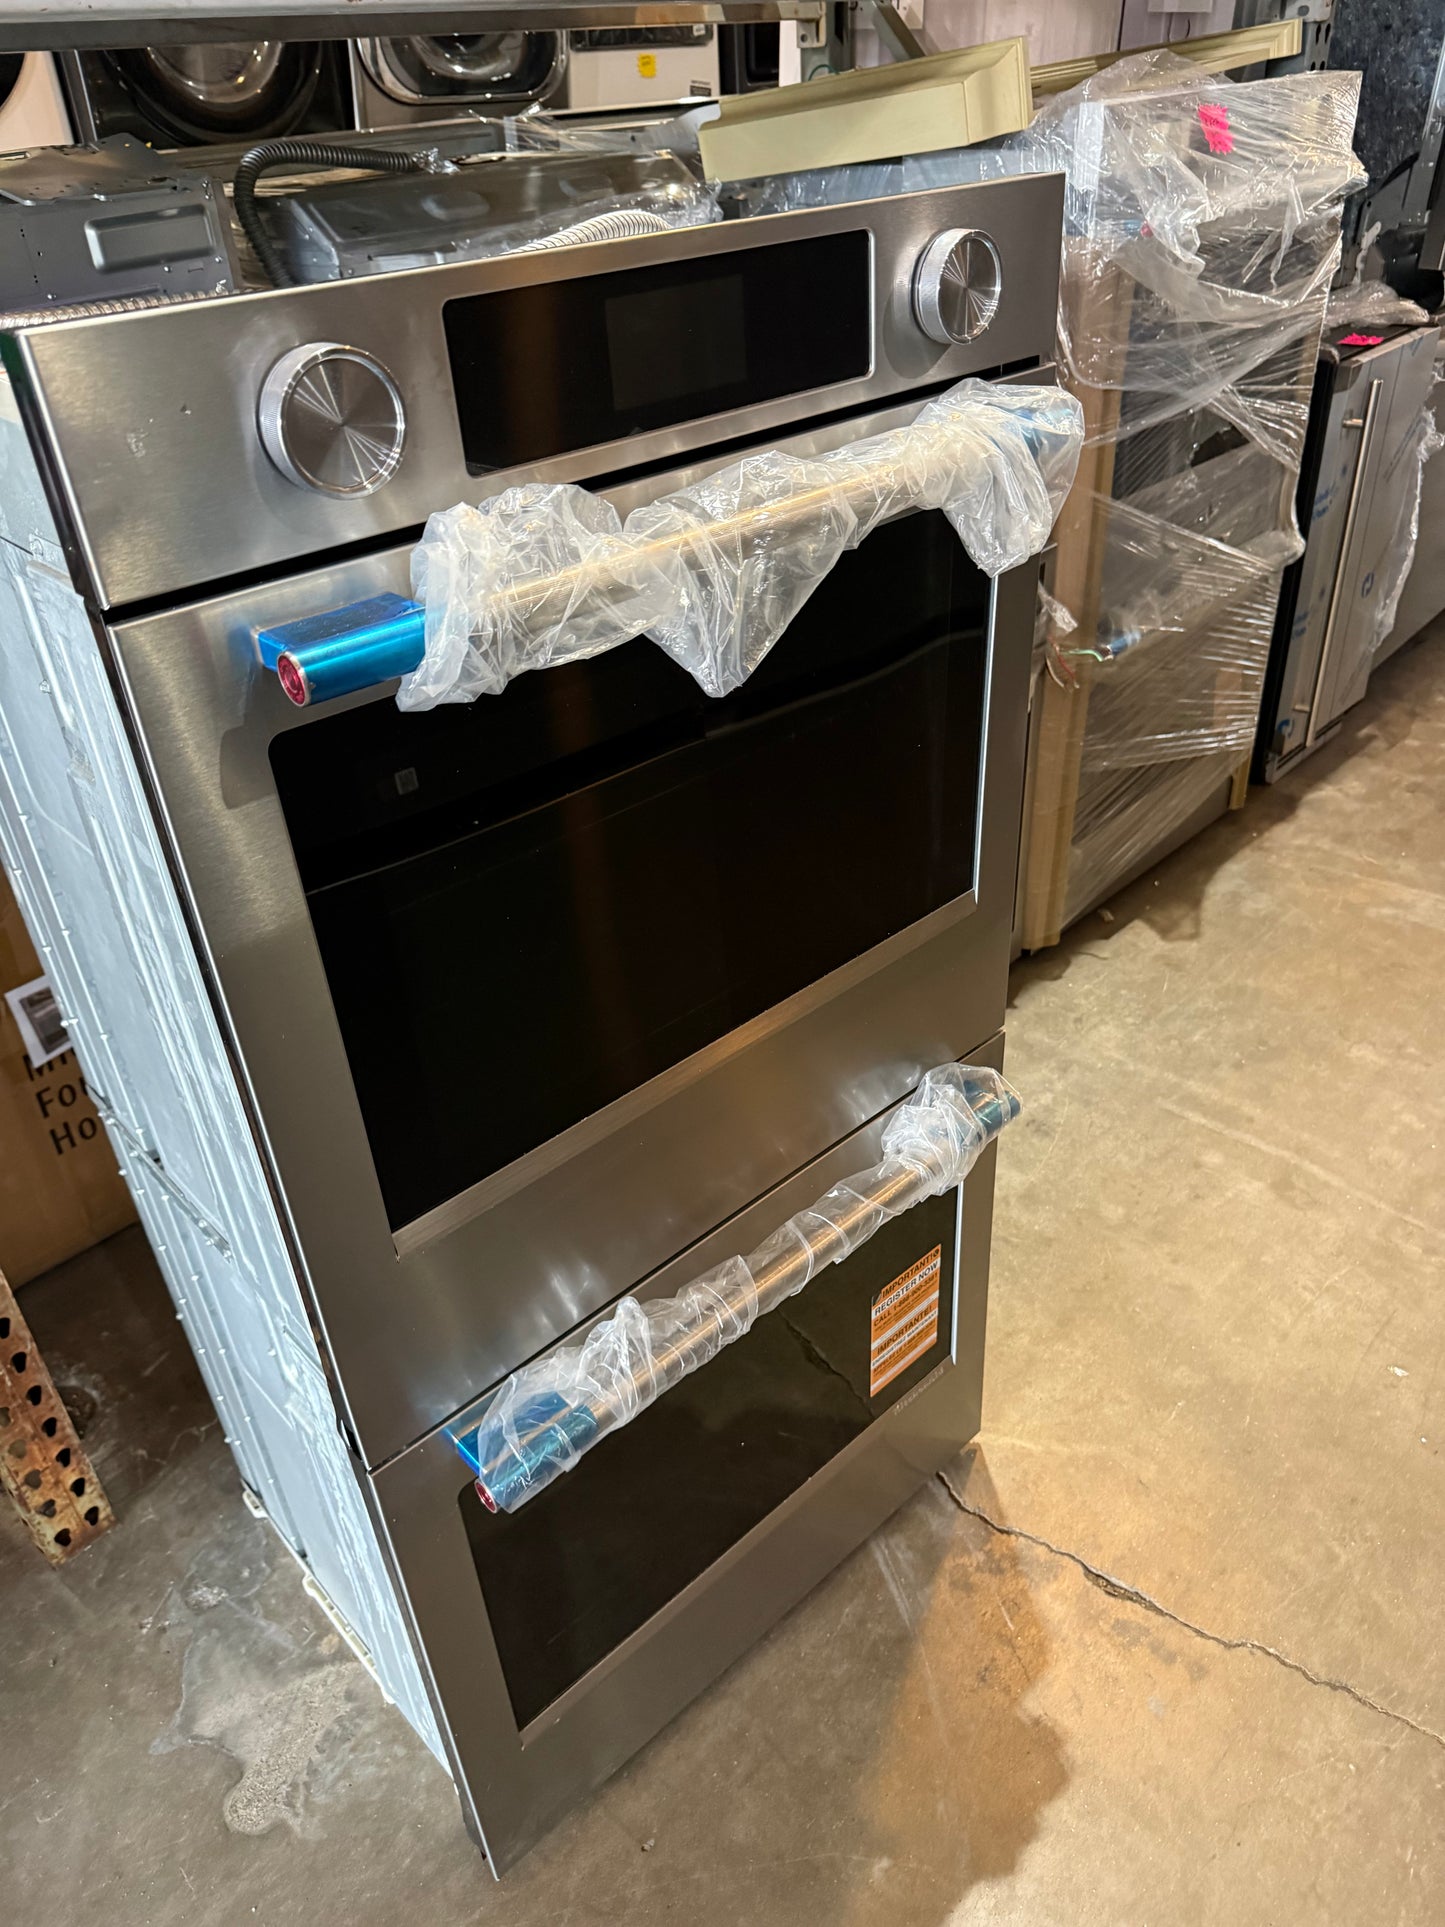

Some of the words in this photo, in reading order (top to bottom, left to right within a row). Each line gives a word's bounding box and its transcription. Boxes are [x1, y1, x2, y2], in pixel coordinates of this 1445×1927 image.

[875, 1278, 917, 1316] REGISTER
[918, 1261, 938, 1280] NOW
[873, 1310, 892, 1327] CALL
